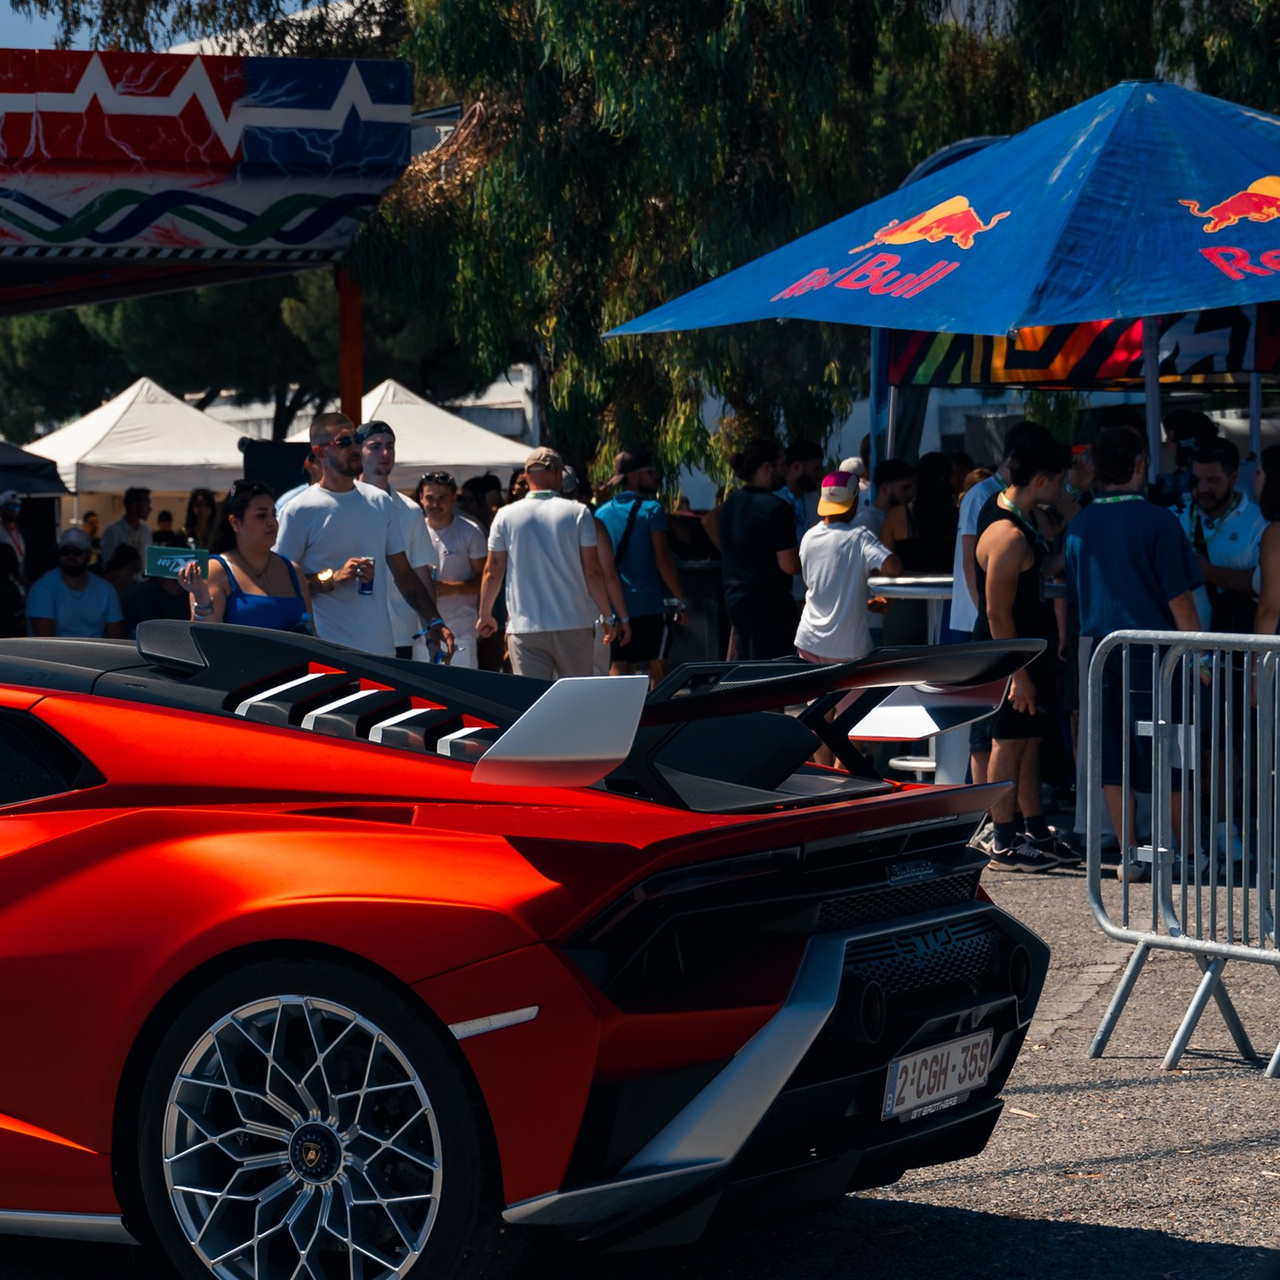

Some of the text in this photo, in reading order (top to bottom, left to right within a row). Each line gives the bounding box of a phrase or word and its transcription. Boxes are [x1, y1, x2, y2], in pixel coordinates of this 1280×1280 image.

[770, 253, 960, 302] Red Bull
[894, 925, 953, 954] STO
